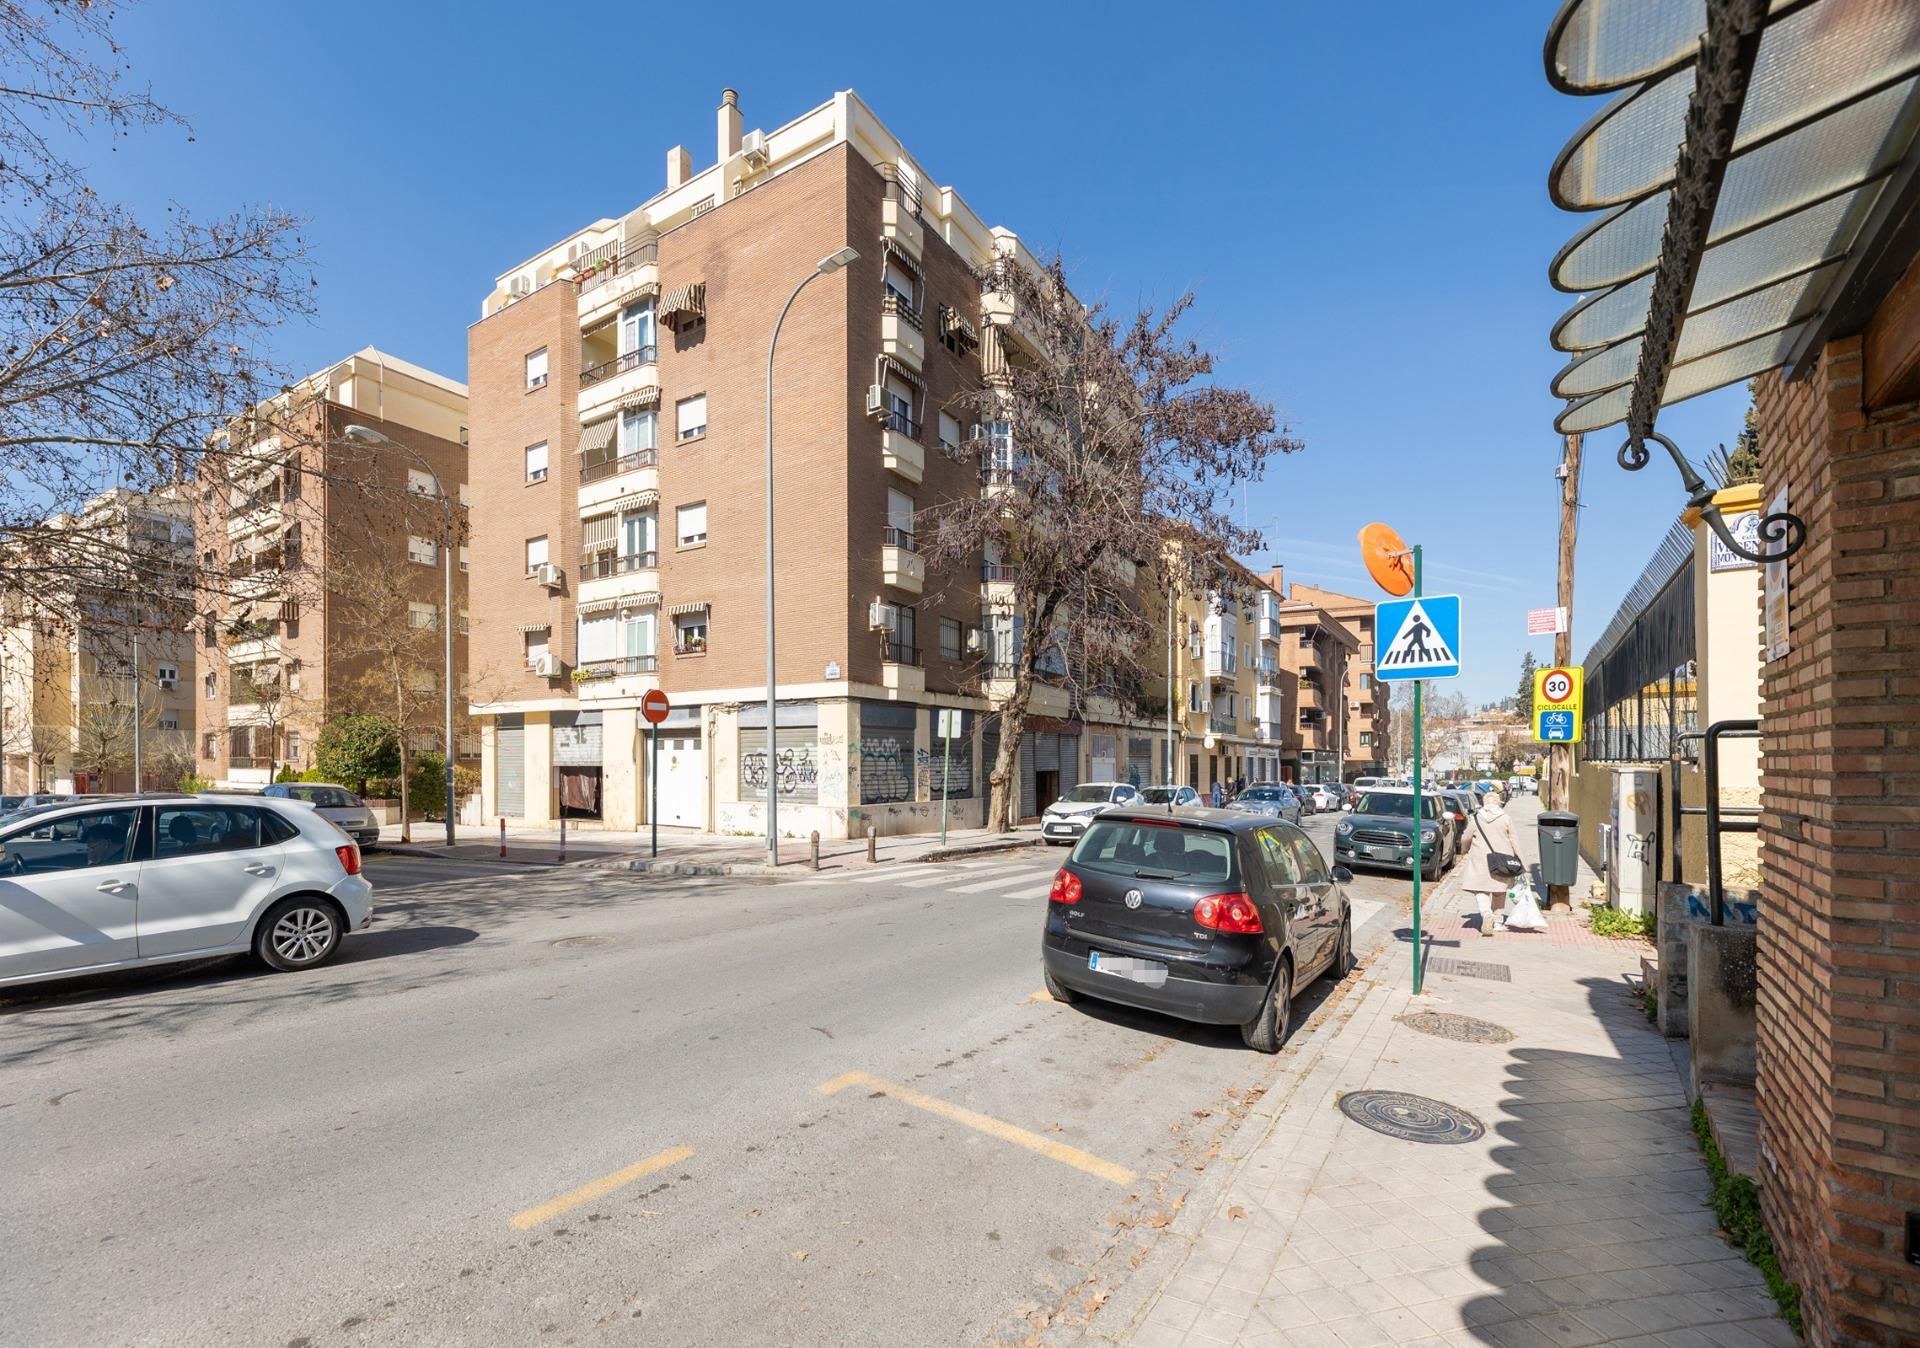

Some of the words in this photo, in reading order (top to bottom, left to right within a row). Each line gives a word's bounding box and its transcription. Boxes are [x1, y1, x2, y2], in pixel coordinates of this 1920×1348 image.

[1548, 681, 1566, 692] 30
[1537, 703, 1577, 711] CICLOCALLE
[1193, 932, 1208, 940] TDI
